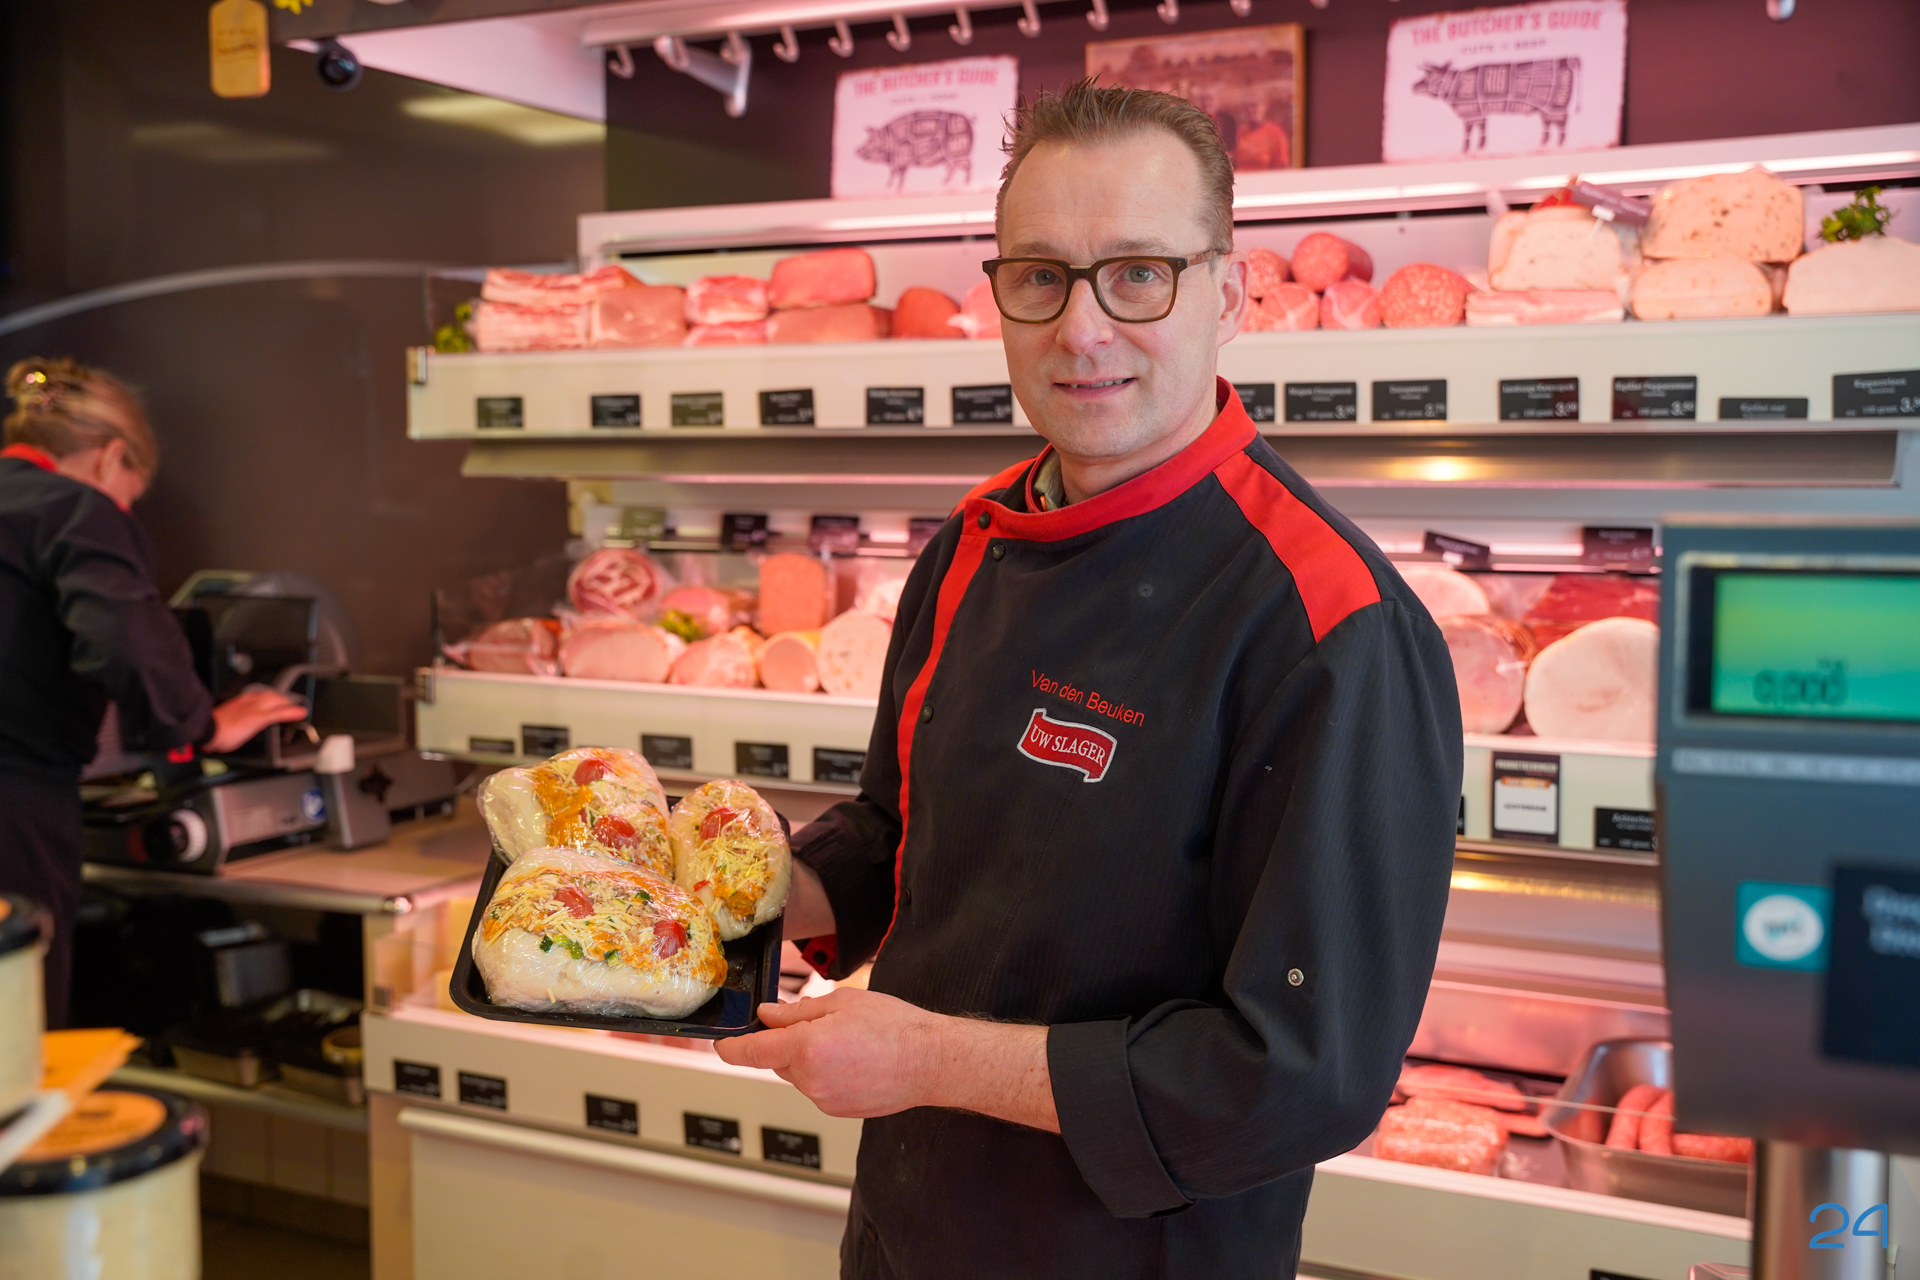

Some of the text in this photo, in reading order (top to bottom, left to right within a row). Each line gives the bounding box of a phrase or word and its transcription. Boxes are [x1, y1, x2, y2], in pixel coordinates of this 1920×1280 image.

[1411, 8, 1602, 46] THE BUTCHER'S GUIDE
[854, 80, 878, 96] THE
[1031, 669, 1146, 727] Van den Beuken
[1030, 724, 1106, 768] UW SLAGER
